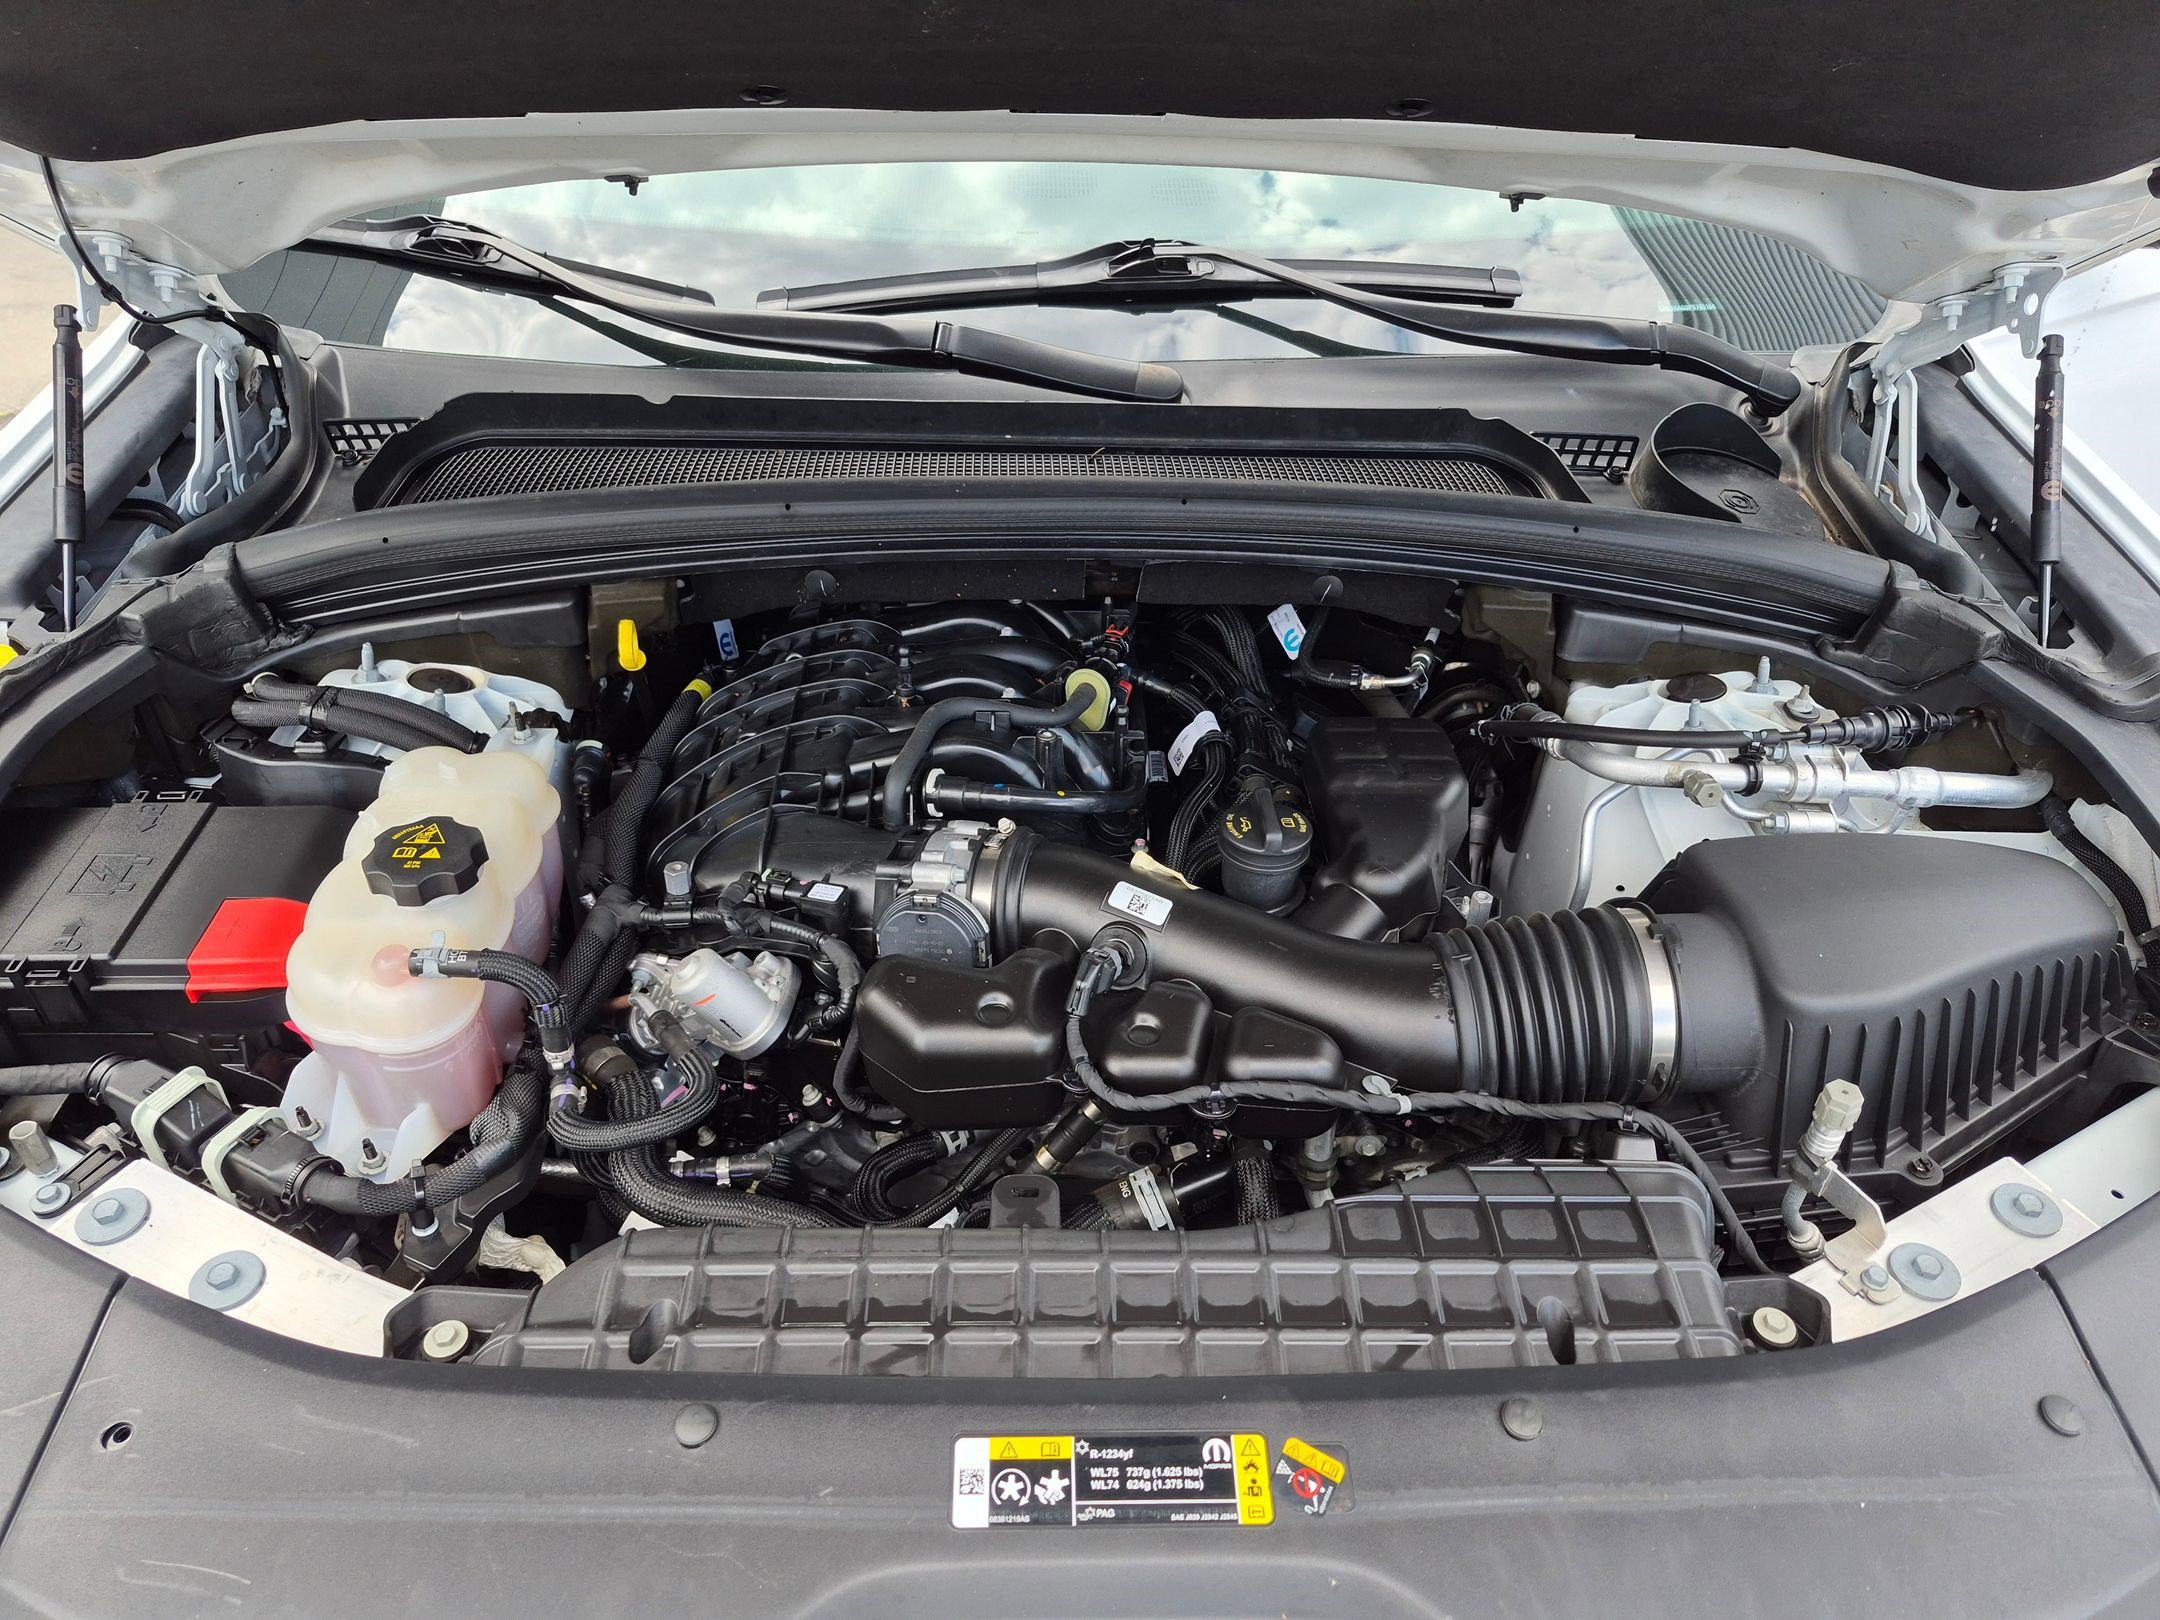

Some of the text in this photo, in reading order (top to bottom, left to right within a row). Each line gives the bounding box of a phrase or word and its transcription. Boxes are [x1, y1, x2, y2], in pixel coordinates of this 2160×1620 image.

[1119, 1180, 1131, 1198] ENG
[1090, 1448, 1134, 1461] R-1234yf
[1090, 1466, 1203, 1479] WL75 737g (1.625 lbs)
[1090, 1478, 1204, 1492] WL74 624g (1.375 lbs)
[1096, 1509, 1115, 1518] PAG
